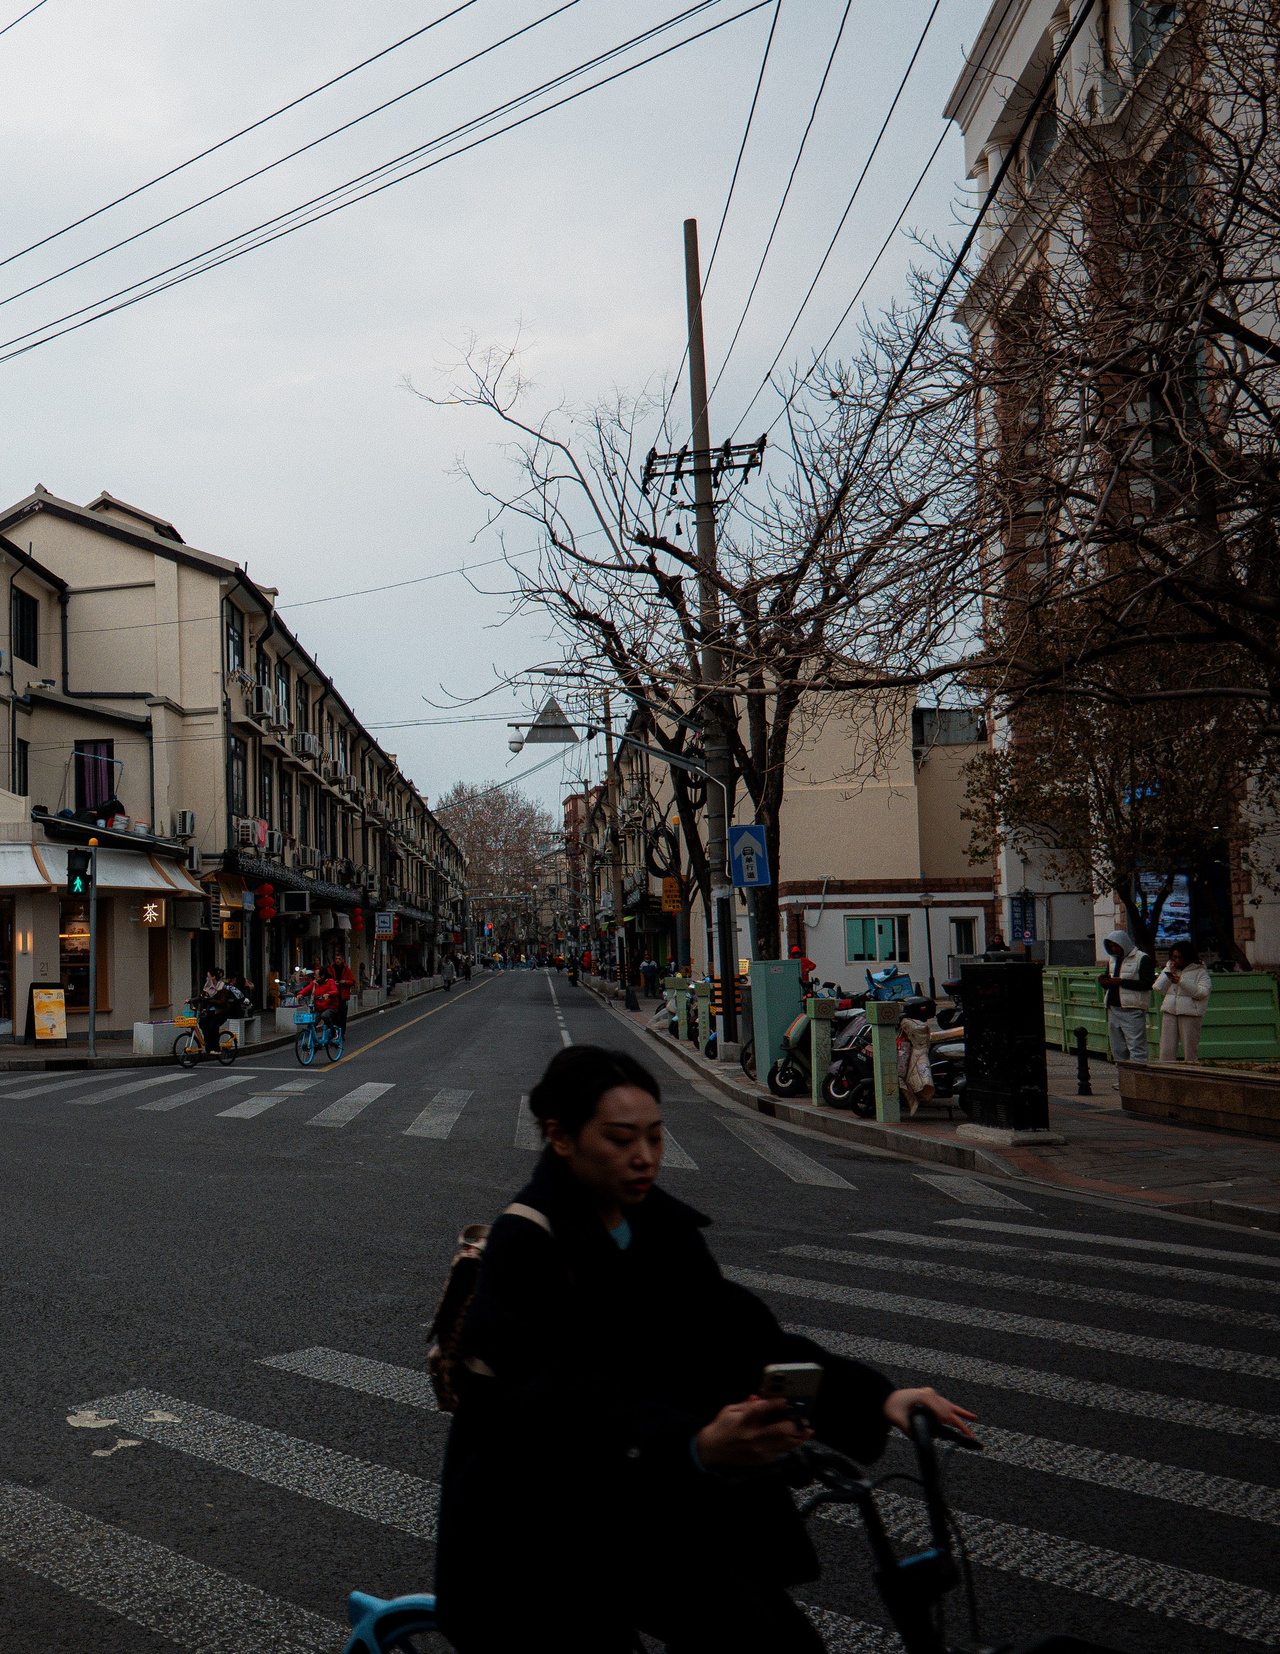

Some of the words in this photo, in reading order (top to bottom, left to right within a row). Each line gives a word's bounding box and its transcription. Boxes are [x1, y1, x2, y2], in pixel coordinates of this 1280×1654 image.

[745, 856, 755, 879] 单行道
[142, 902, 159, 923] 茶
[1012, 899, 1022, 938] 机动车出入口
[39, 962, 49, 973] 21
